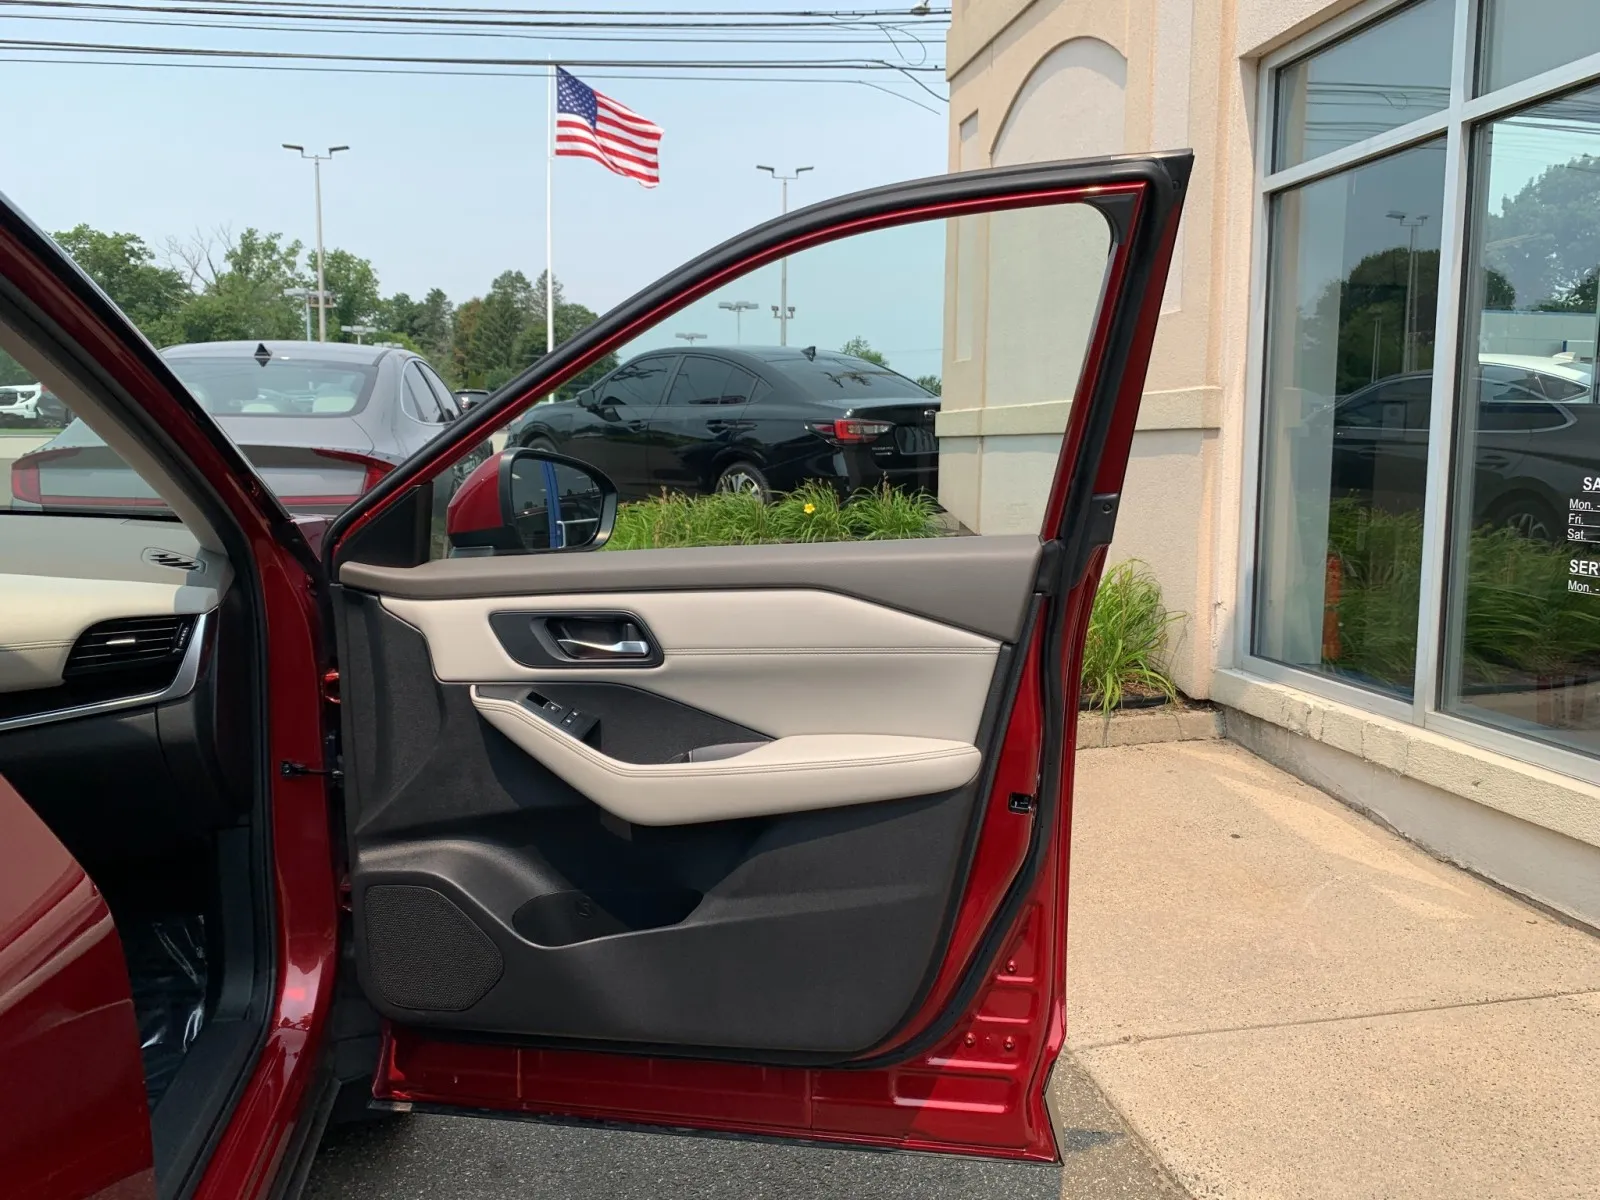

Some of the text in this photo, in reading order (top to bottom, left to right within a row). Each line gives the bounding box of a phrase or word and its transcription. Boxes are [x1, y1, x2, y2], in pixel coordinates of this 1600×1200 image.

[1583, 477, 1600, 491] SA
[1569, 498, 1594, 510] Mon.
[1568, 513, 1584, 525] Fri.
[1567, 528, 1586, 540] Sat.
[1569, 559, 1600, 576] SER
[1568, 580, 1592, 593] Mon.
